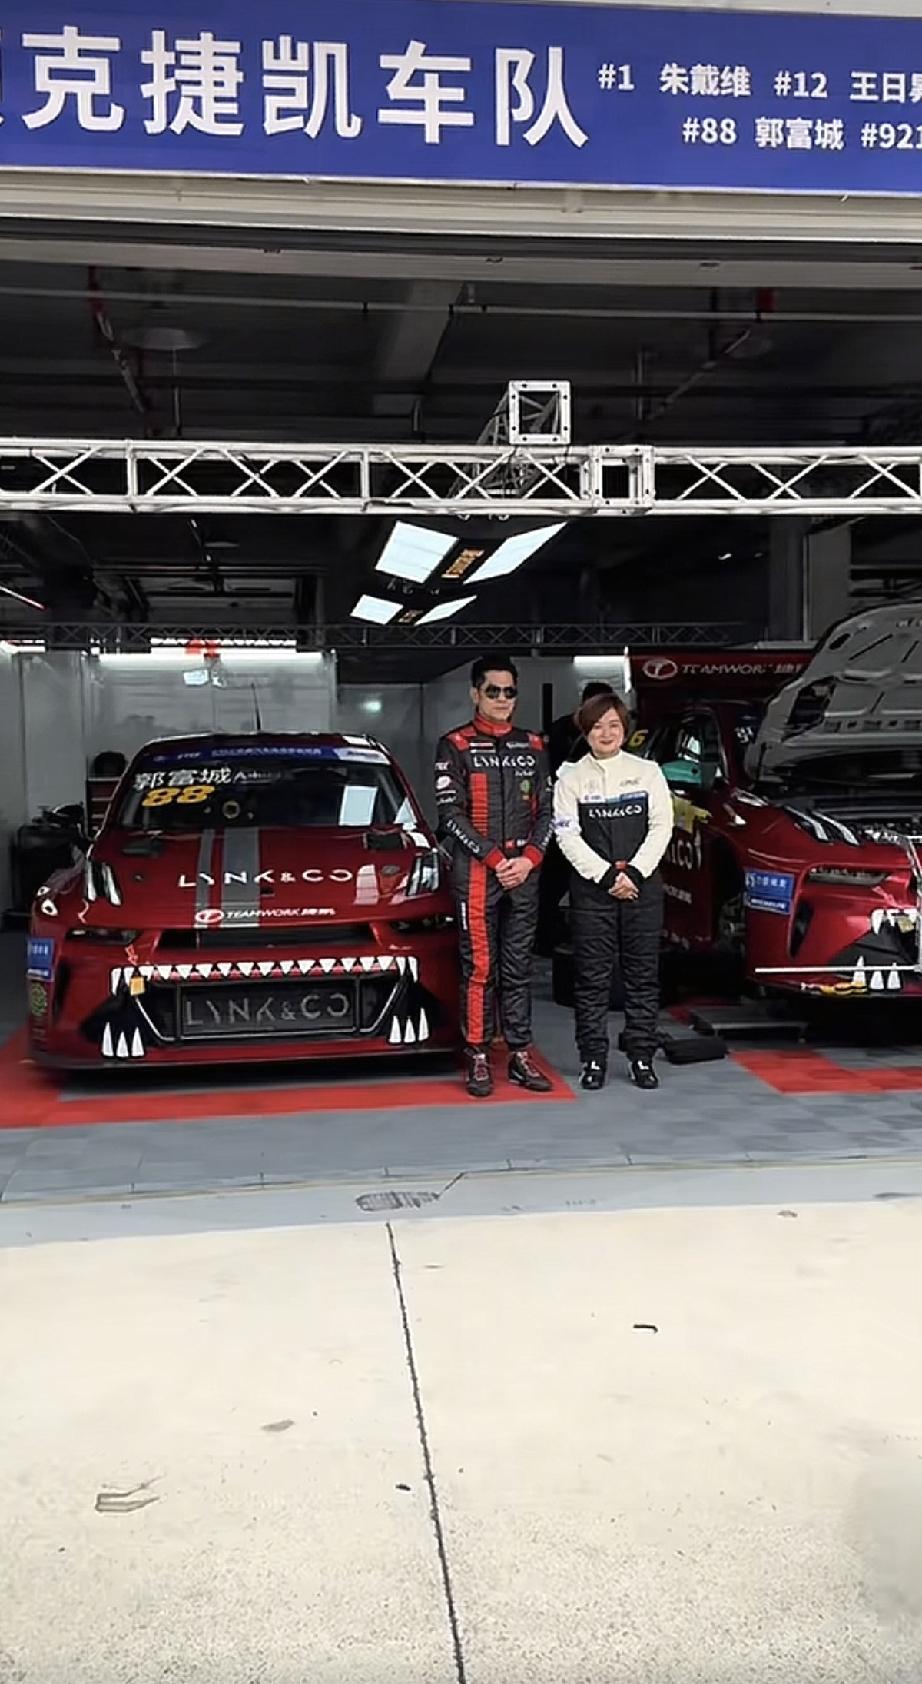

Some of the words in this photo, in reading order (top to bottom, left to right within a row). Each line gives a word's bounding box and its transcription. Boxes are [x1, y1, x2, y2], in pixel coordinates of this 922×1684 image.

[0, 25, 588, 148] 克捷凯车队
[598, 63, 635, 92] #1
[659, 62, 752, 98] 朱戴维
[773, 71, 828, 99] #12
[682, 117, 737, 145] #88
[754, 116, 845, 151] 郭富城
[141, 785, 215, 807] 88
[178, 868, 354, 888] LYNK&CO
[184, 992, 350, 1026] LYNK&CO
